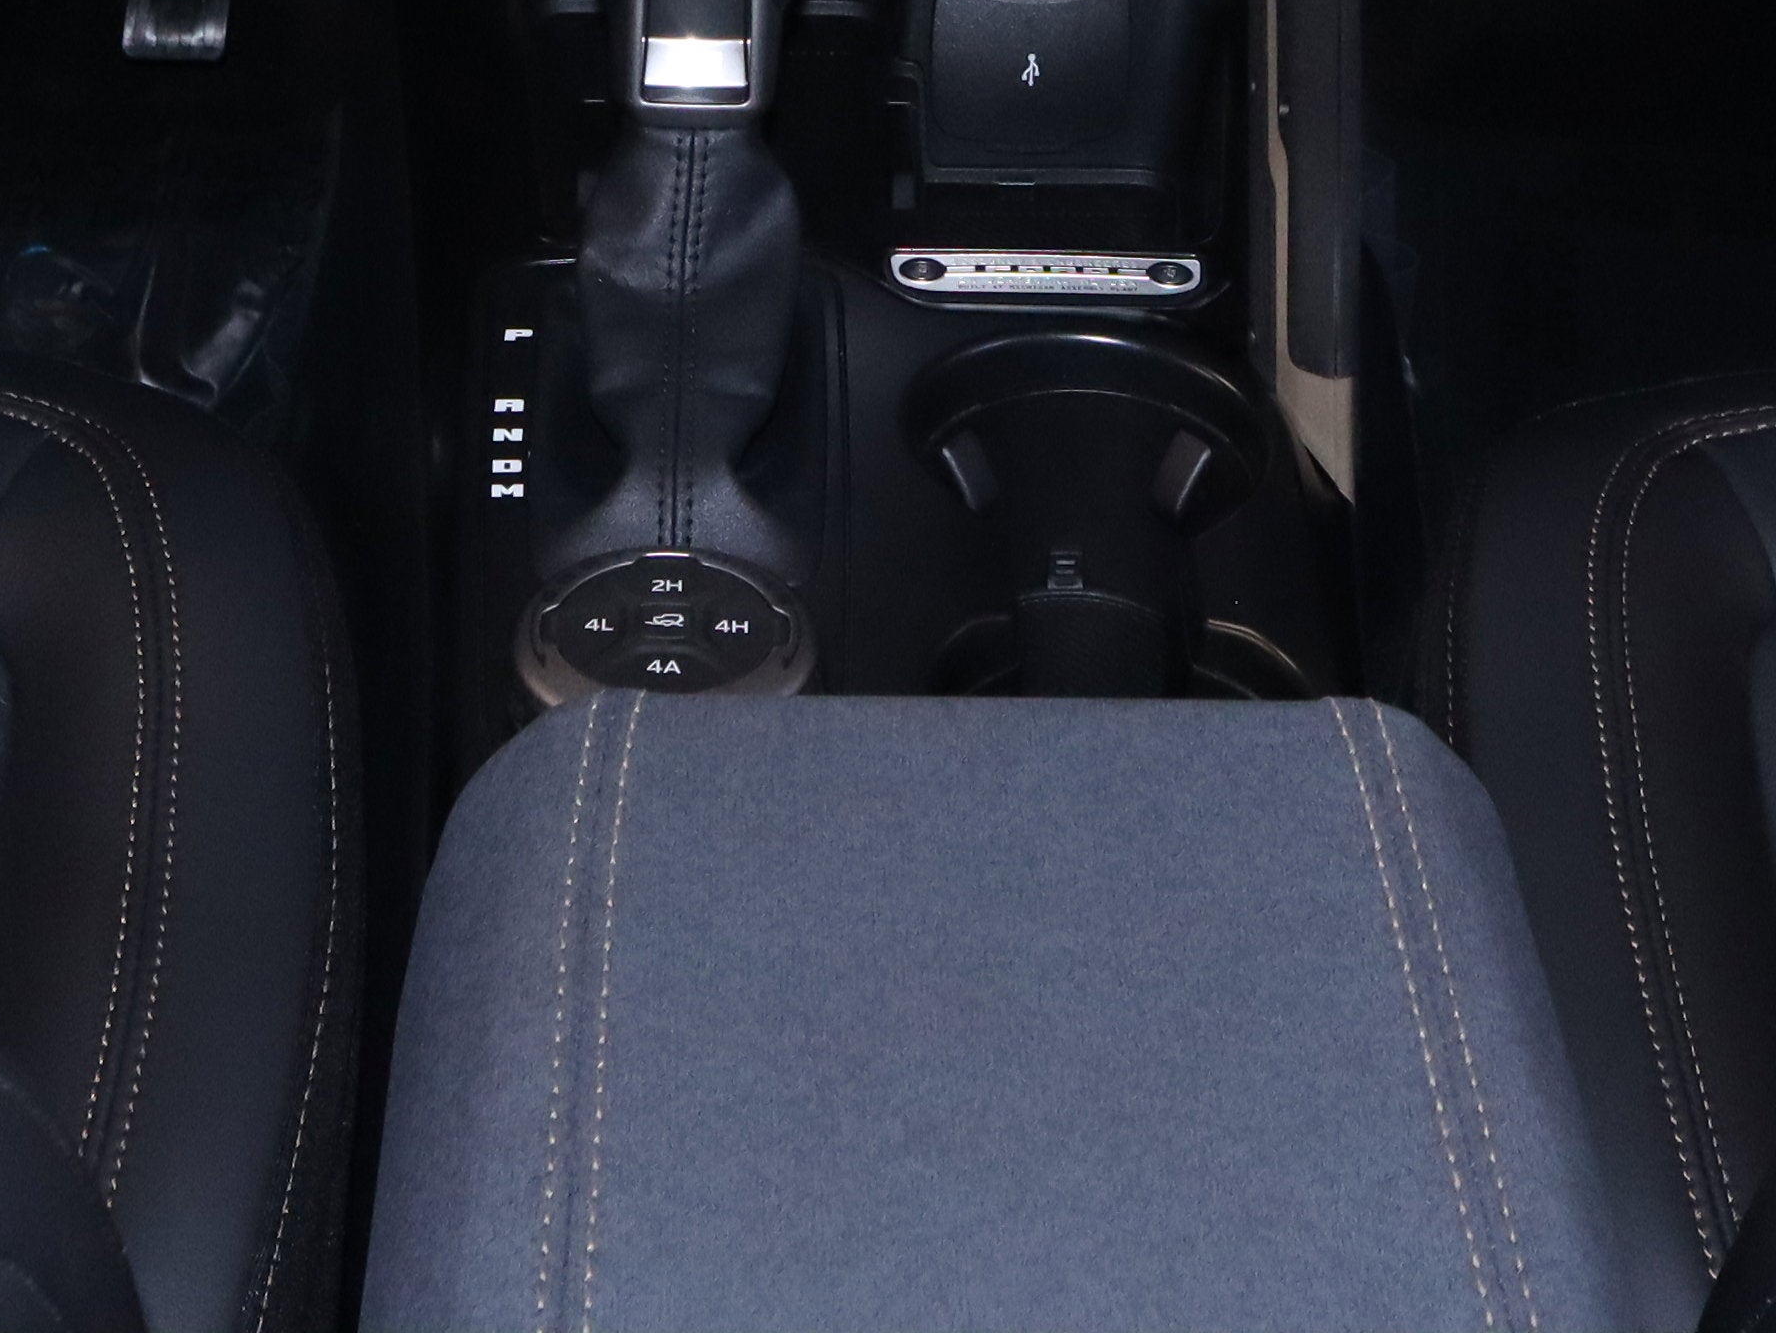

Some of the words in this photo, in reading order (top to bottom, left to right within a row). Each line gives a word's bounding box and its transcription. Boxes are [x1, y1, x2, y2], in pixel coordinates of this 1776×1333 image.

[504, 328, 533, 341] P
[492, 428, 523, 441] N
[492, 459, 522, 473] D
[491, 483, 524, 497] M
[651, 579, 683, 593] 2H
[584, 618, 614, 631] 4L
[714, 620, 749, 633] 4H
[646, 660, 682, 674] 4A
